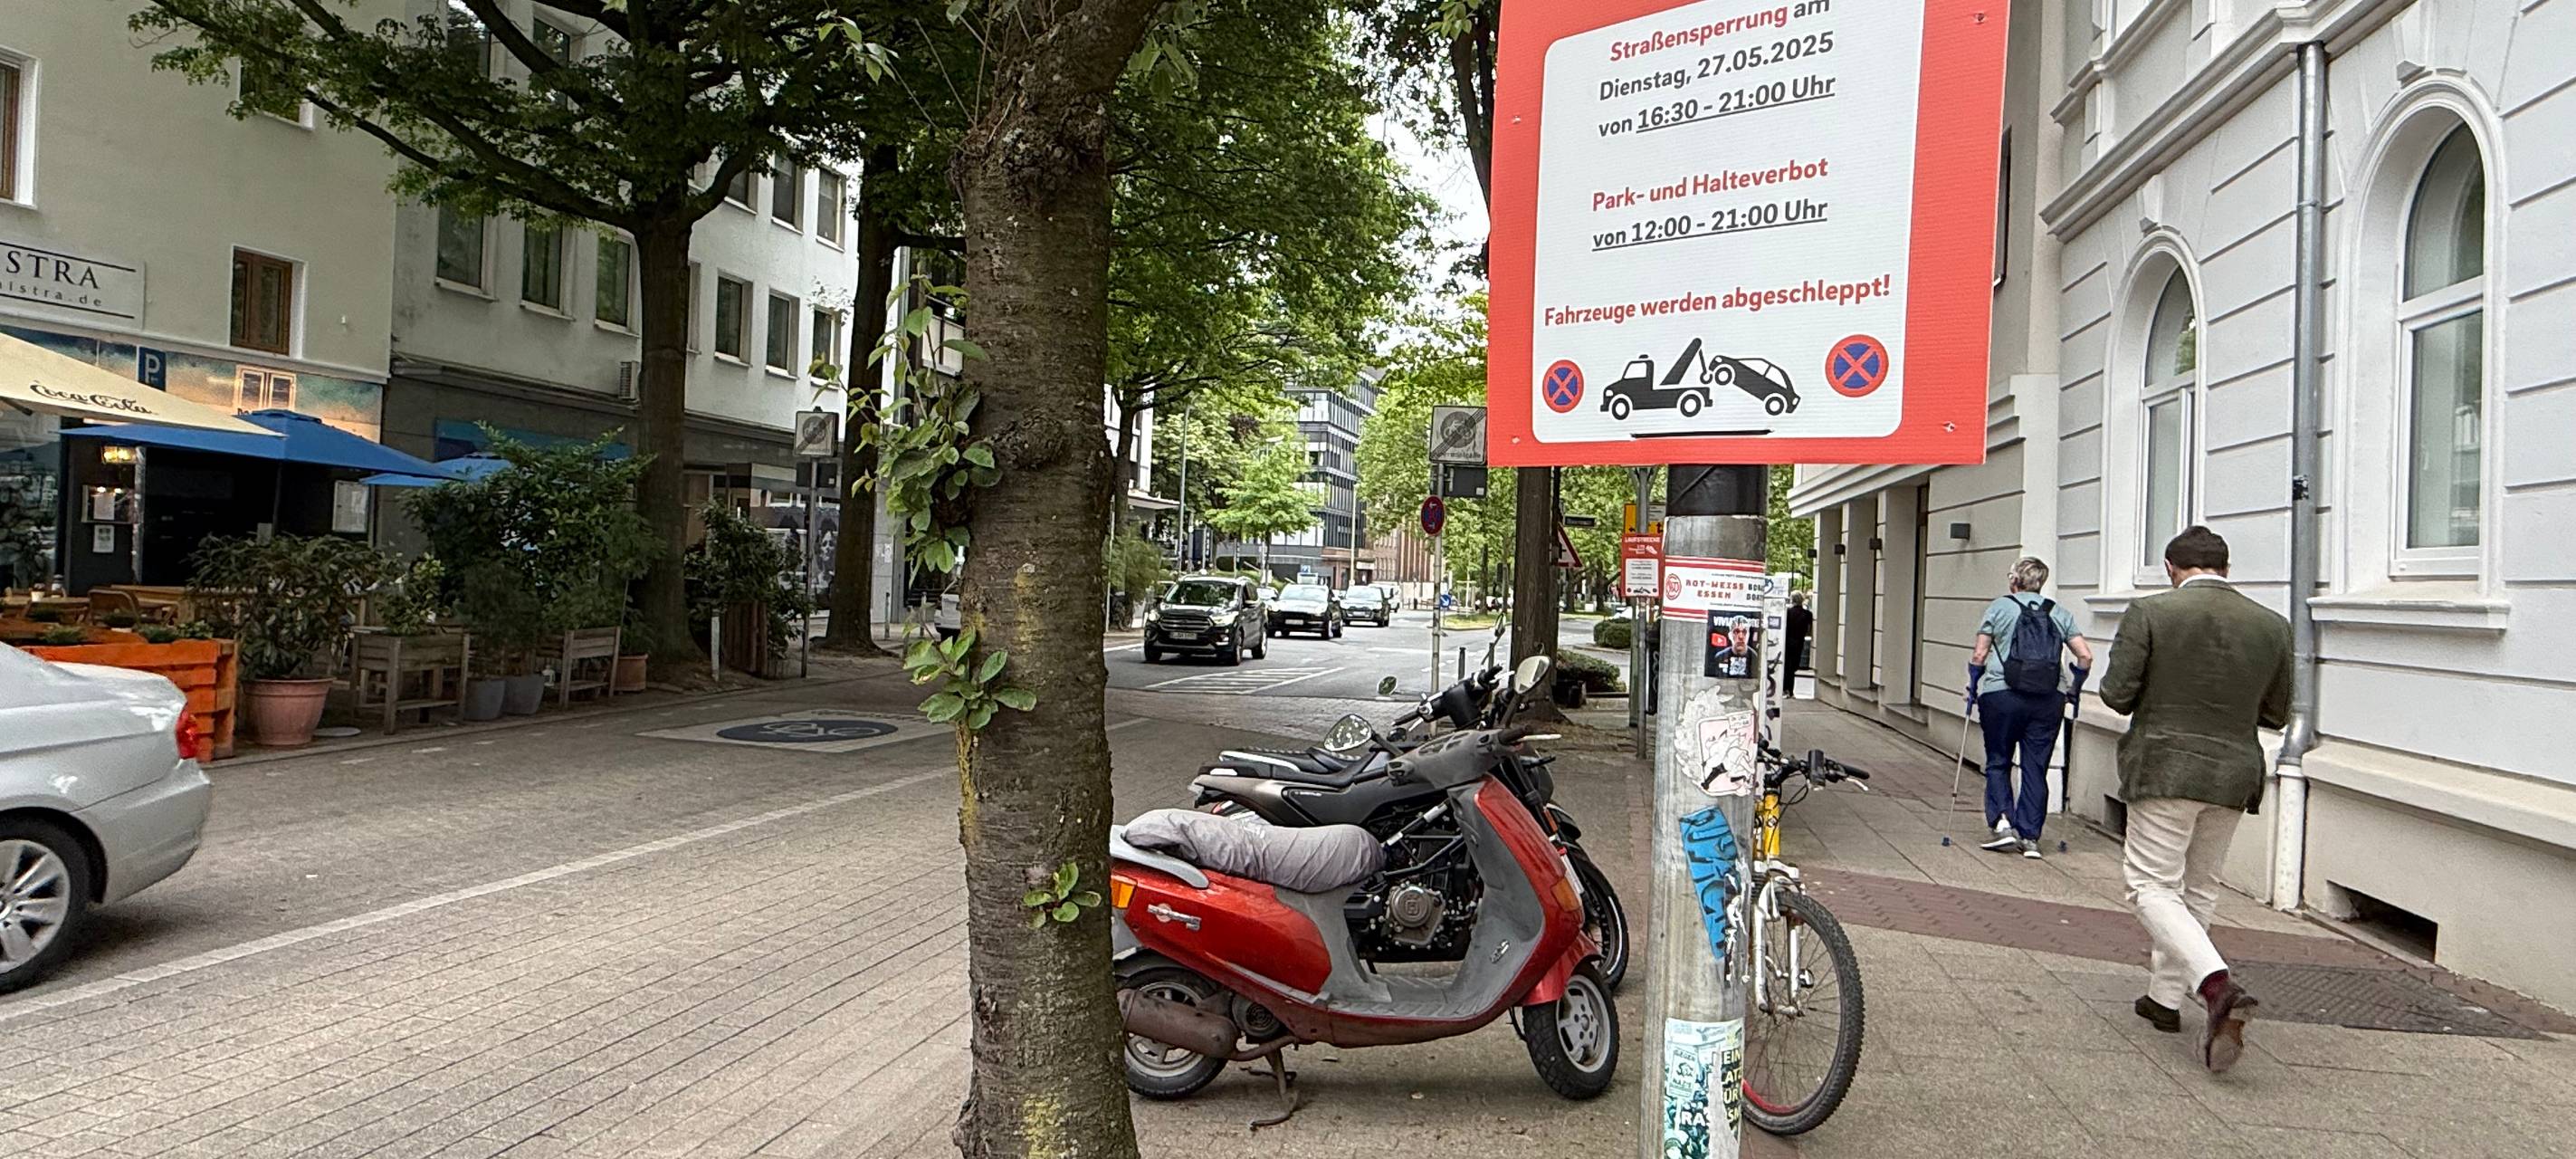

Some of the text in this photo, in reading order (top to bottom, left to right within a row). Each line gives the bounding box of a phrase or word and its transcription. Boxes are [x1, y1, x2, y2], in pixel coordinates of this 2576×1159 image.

[1609, 0, 1831, 62] Straßensperrung am
[1599, 30, 1834, 101] Dienstag, 27.05.2025
[1598, 117, 1633, 137] von
[1636, 99, 1698, 131] 16:30
[1719, 81, 1786, 114] 21:00
[1791, 74, 1837, 99] Uhr
[1592, 158, 1829, 211] Park- und Halteverbot
[1592, 230, 1627, 249] von
[1631, 215, 1692, 244] 12:00
[1711, 203, 1779, 233] 21:00
[1784, 197, 1828, 223] Uhr
[1544, 273, 1891, 327] Fahrzeuge werden abgeschleppt!
